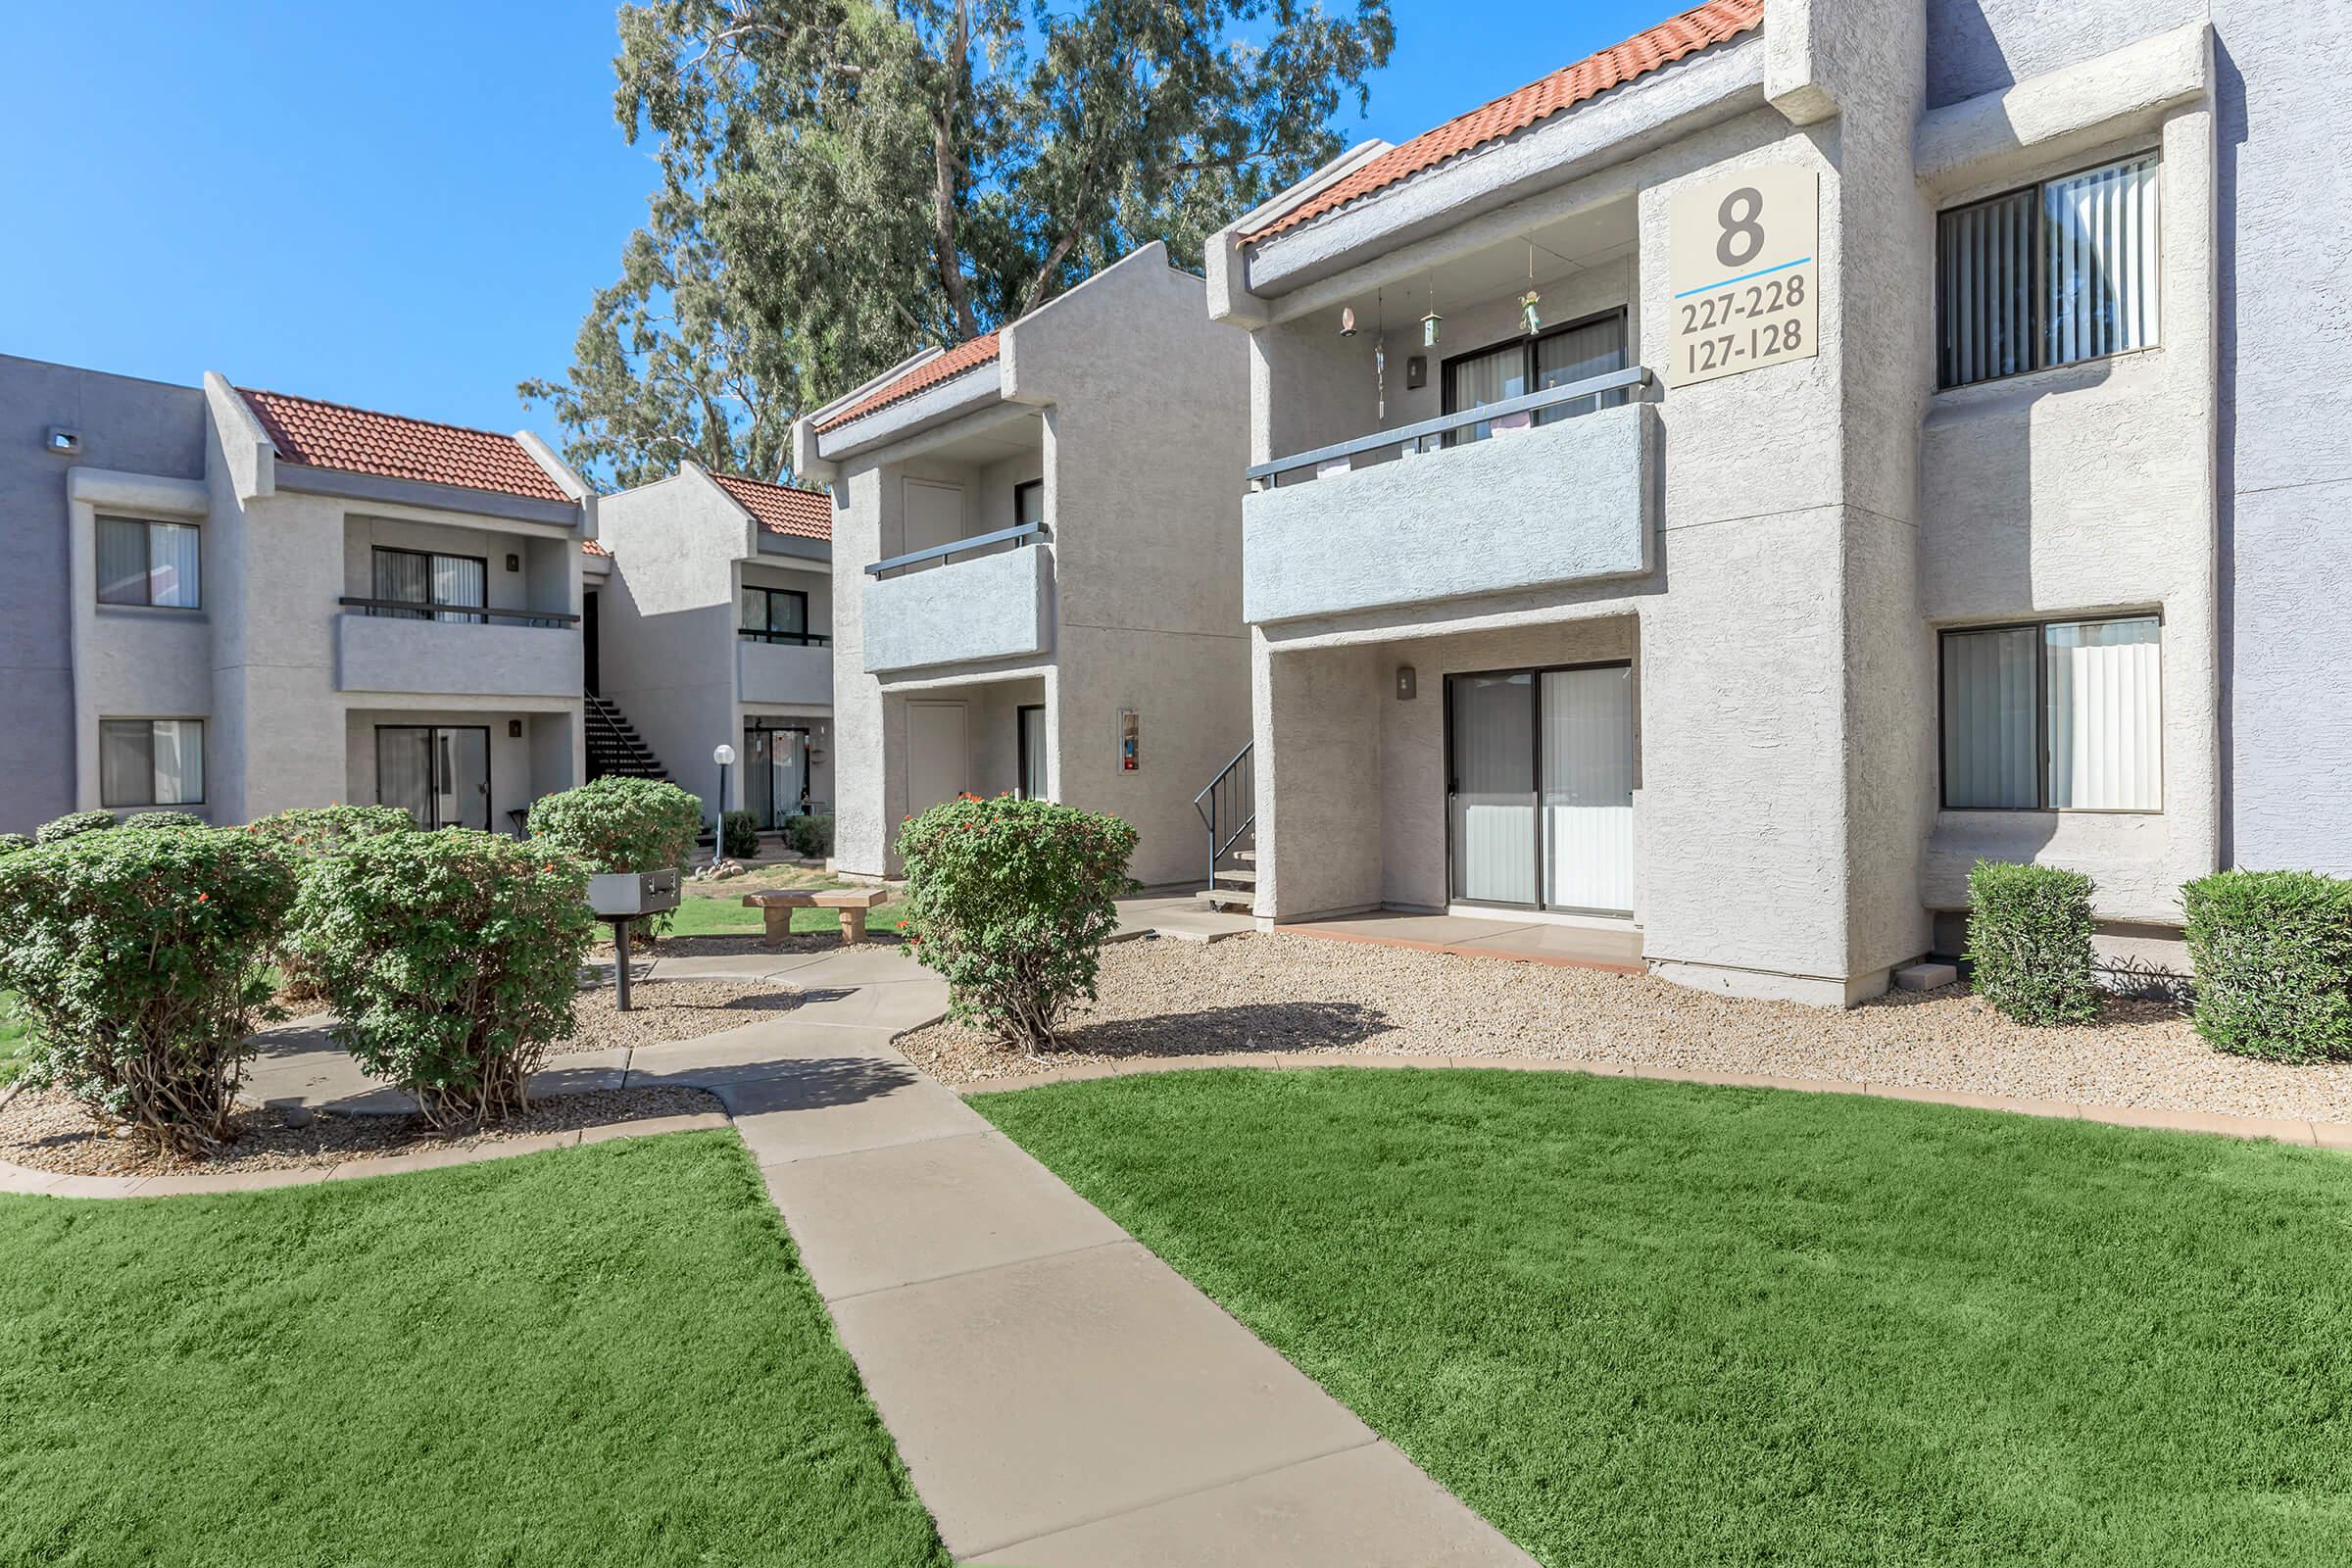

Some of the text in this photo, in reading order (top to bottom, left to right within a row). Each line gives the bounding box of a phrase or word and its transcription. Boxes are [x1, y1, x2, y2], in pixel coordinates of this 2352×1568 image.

[1716, 187, 1765, 268] 8
[1681, 274, 1804, 335] 227-228
[1689, 318, 1802, 373] 127-128
